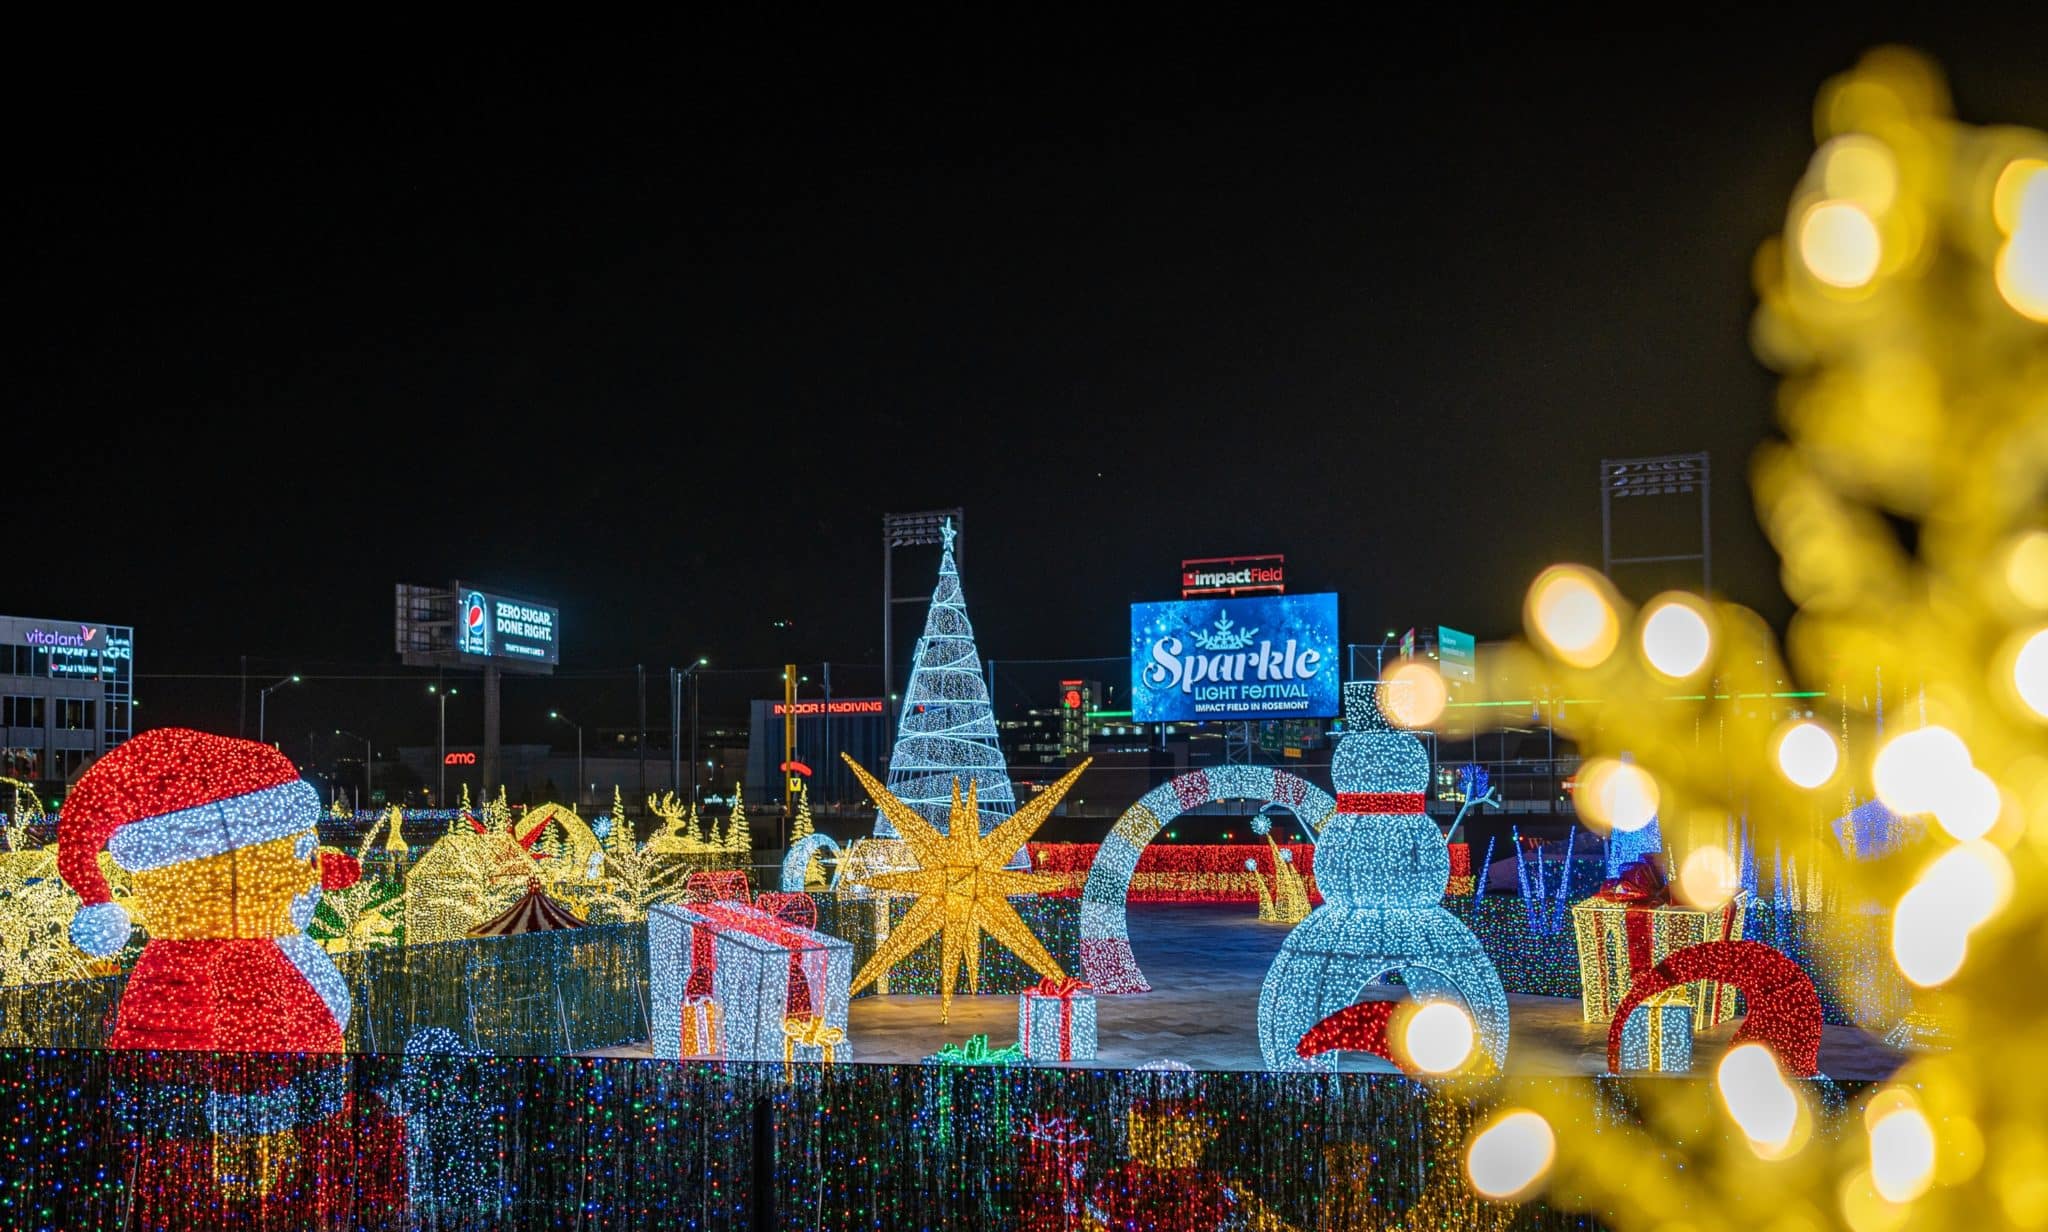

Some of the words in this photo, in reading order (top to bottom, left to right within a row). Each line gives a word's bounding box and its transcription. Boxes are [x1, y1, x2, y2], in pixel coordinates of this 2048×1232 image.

[496, 602, 521, 620] ZERO
[521, 607, 553, 626] SUGAR.
[25, 627, 84, 647] vitalant
[496, 618, 523, 636] DONE
[524, 623, 552, 641] RIGHT.
[1142, 635, 1321, 693] Sparkle
[1195, 685, 1238, 700] LIGHT
[774, 703, 819, 714] INDOOR
[820, 701, 882, 713] SKYDIVING
[1195, 703, 1225, 712] IMPACT
[1226, 702, 1250, 711] FIELD
[1250, 702, 1261, 711] IN
[1261, 700, 1309, 711] ROSEMONT
